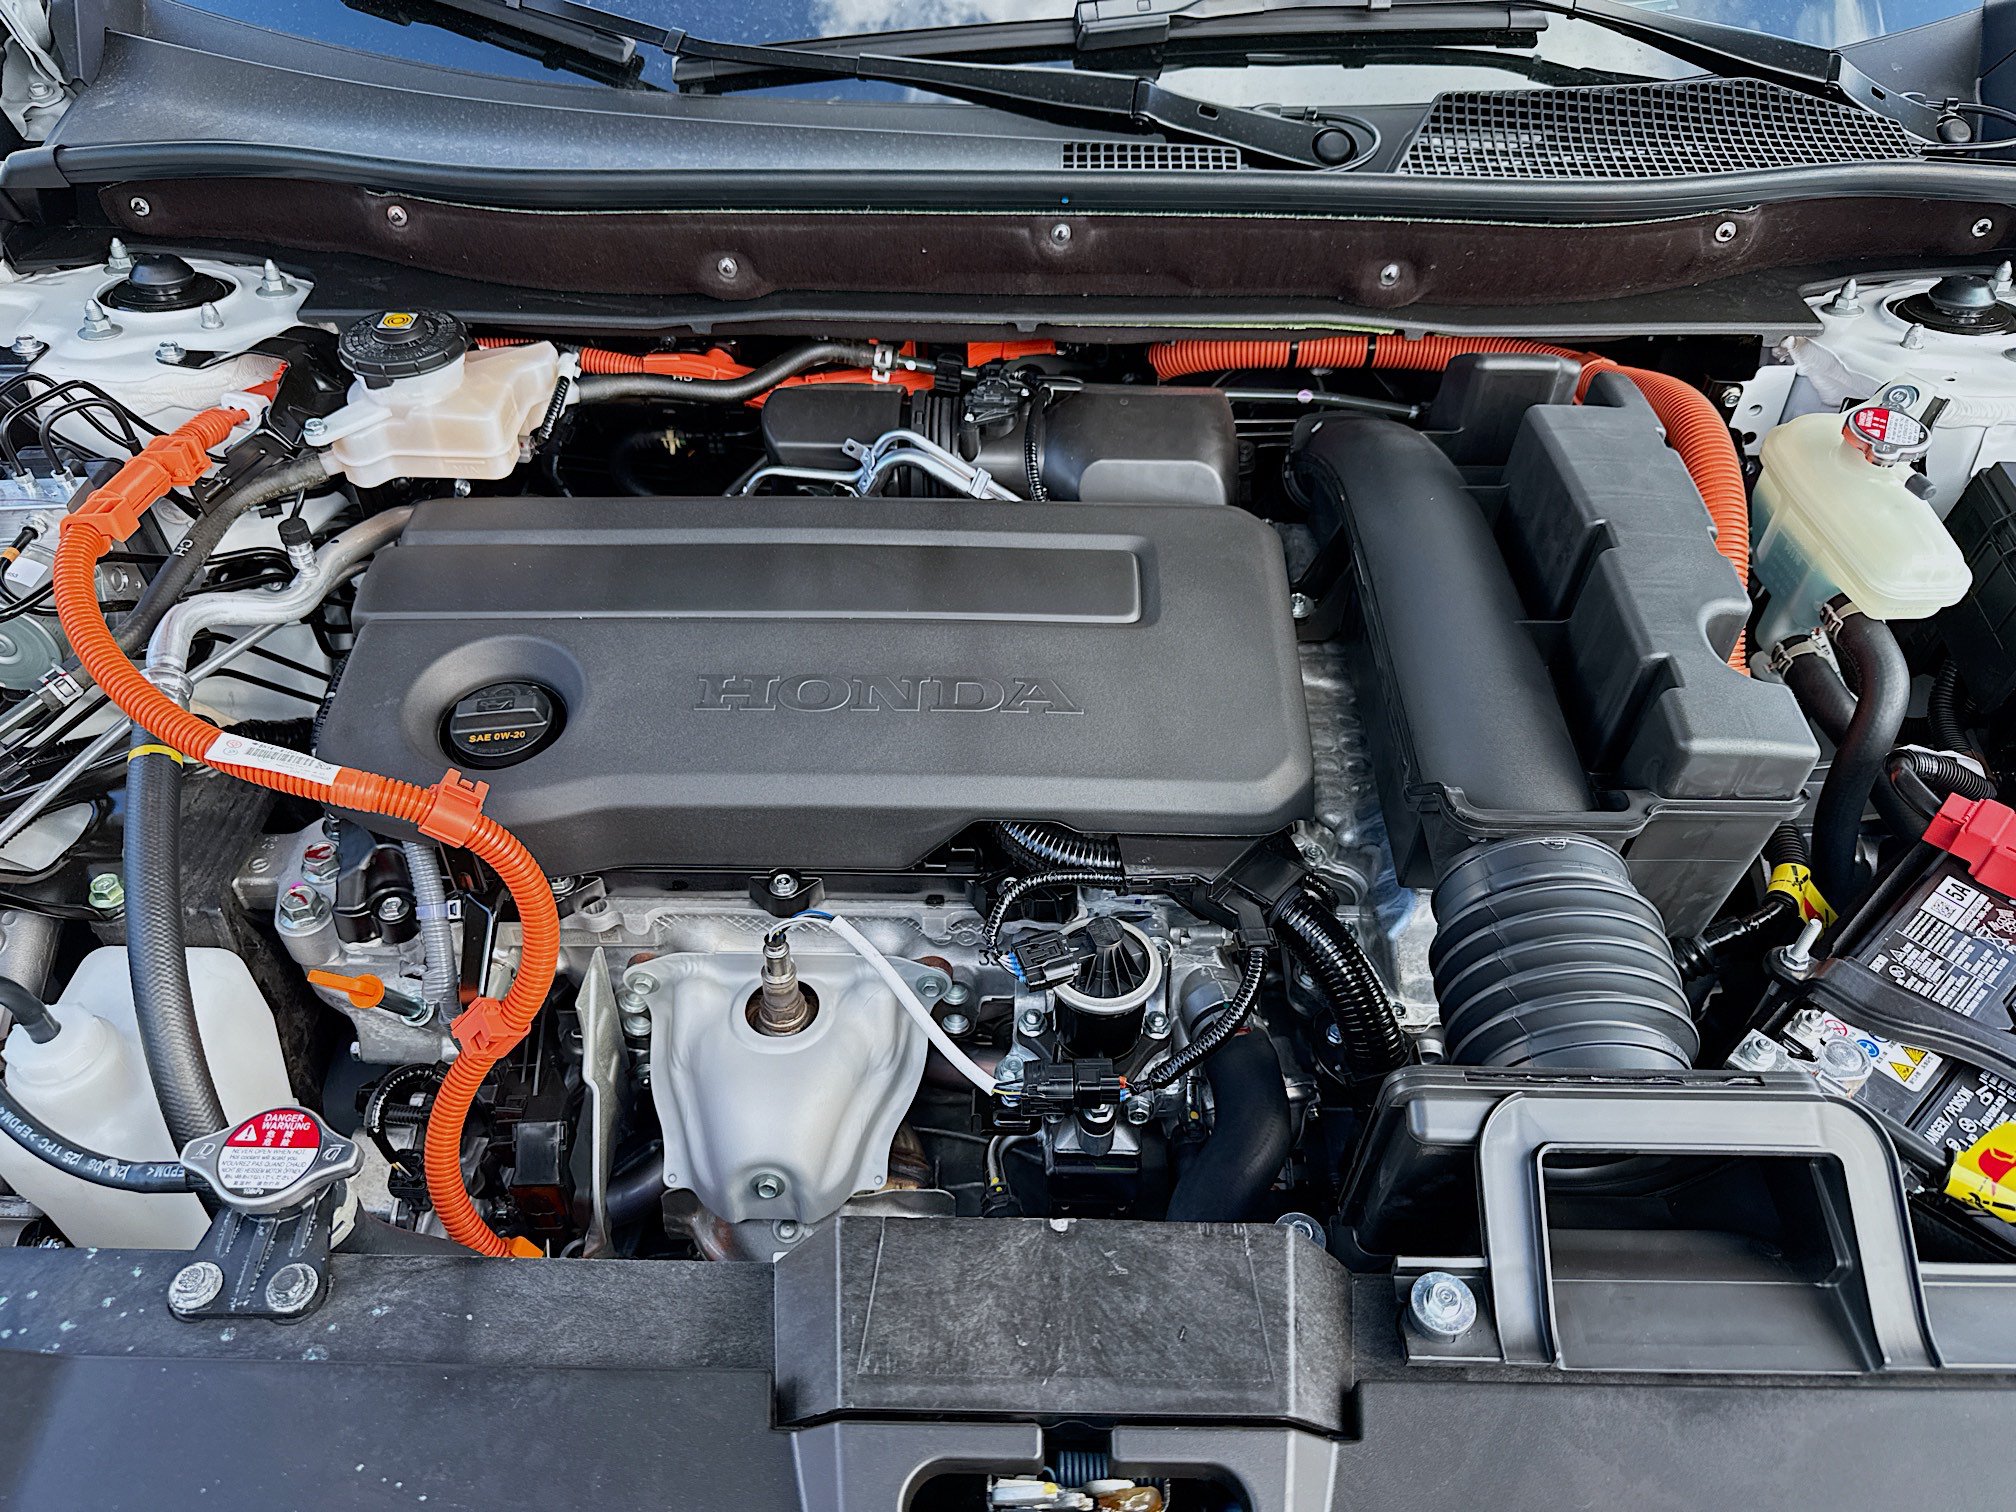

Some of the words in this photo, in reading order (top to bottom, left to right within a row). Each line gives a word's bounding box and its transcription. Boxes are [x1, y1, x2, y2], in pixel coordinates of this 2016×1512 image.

[173, 539, 194, 557] CH
[693, 674, 1085, 714] HONDA
[468, 733, 492, 743] SAE
[493, 730, 526, 741] 0W-20
[1945, 883, 1971, 902] 5A
[264, 1113, 306, 1123] DANGER
[1923, 1085, 1975, 1146] ANGER/POISON
[262, 1121, 311, 1131] WARNUNG
[38, 1138, 63, 1157] TPC
